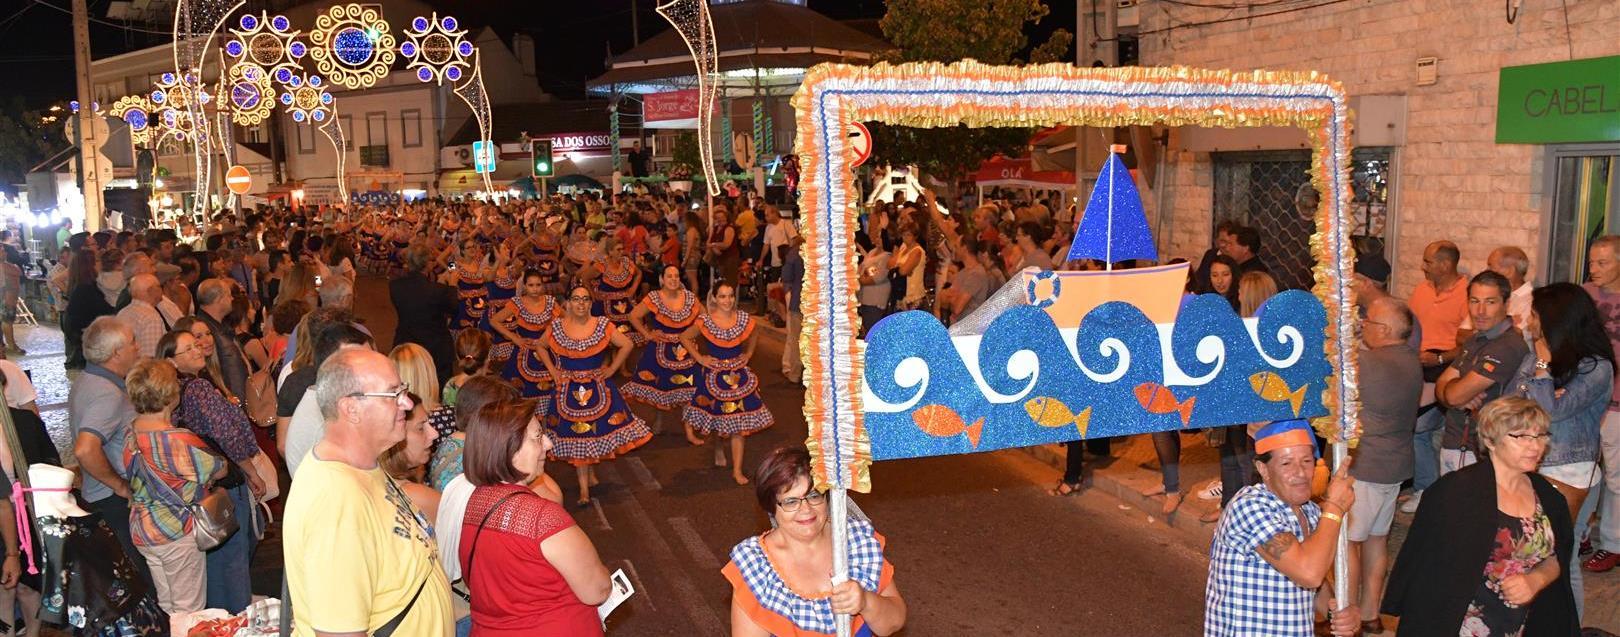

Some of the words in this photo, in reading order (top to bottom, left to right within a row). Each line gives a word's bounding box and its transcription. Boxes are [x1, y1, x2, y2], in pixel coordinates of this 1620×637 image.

[1524, 84, 1620, 117] CABEL
[564, 136, 584, 147] DOS
[585, 135, 610, 146] OSSO
